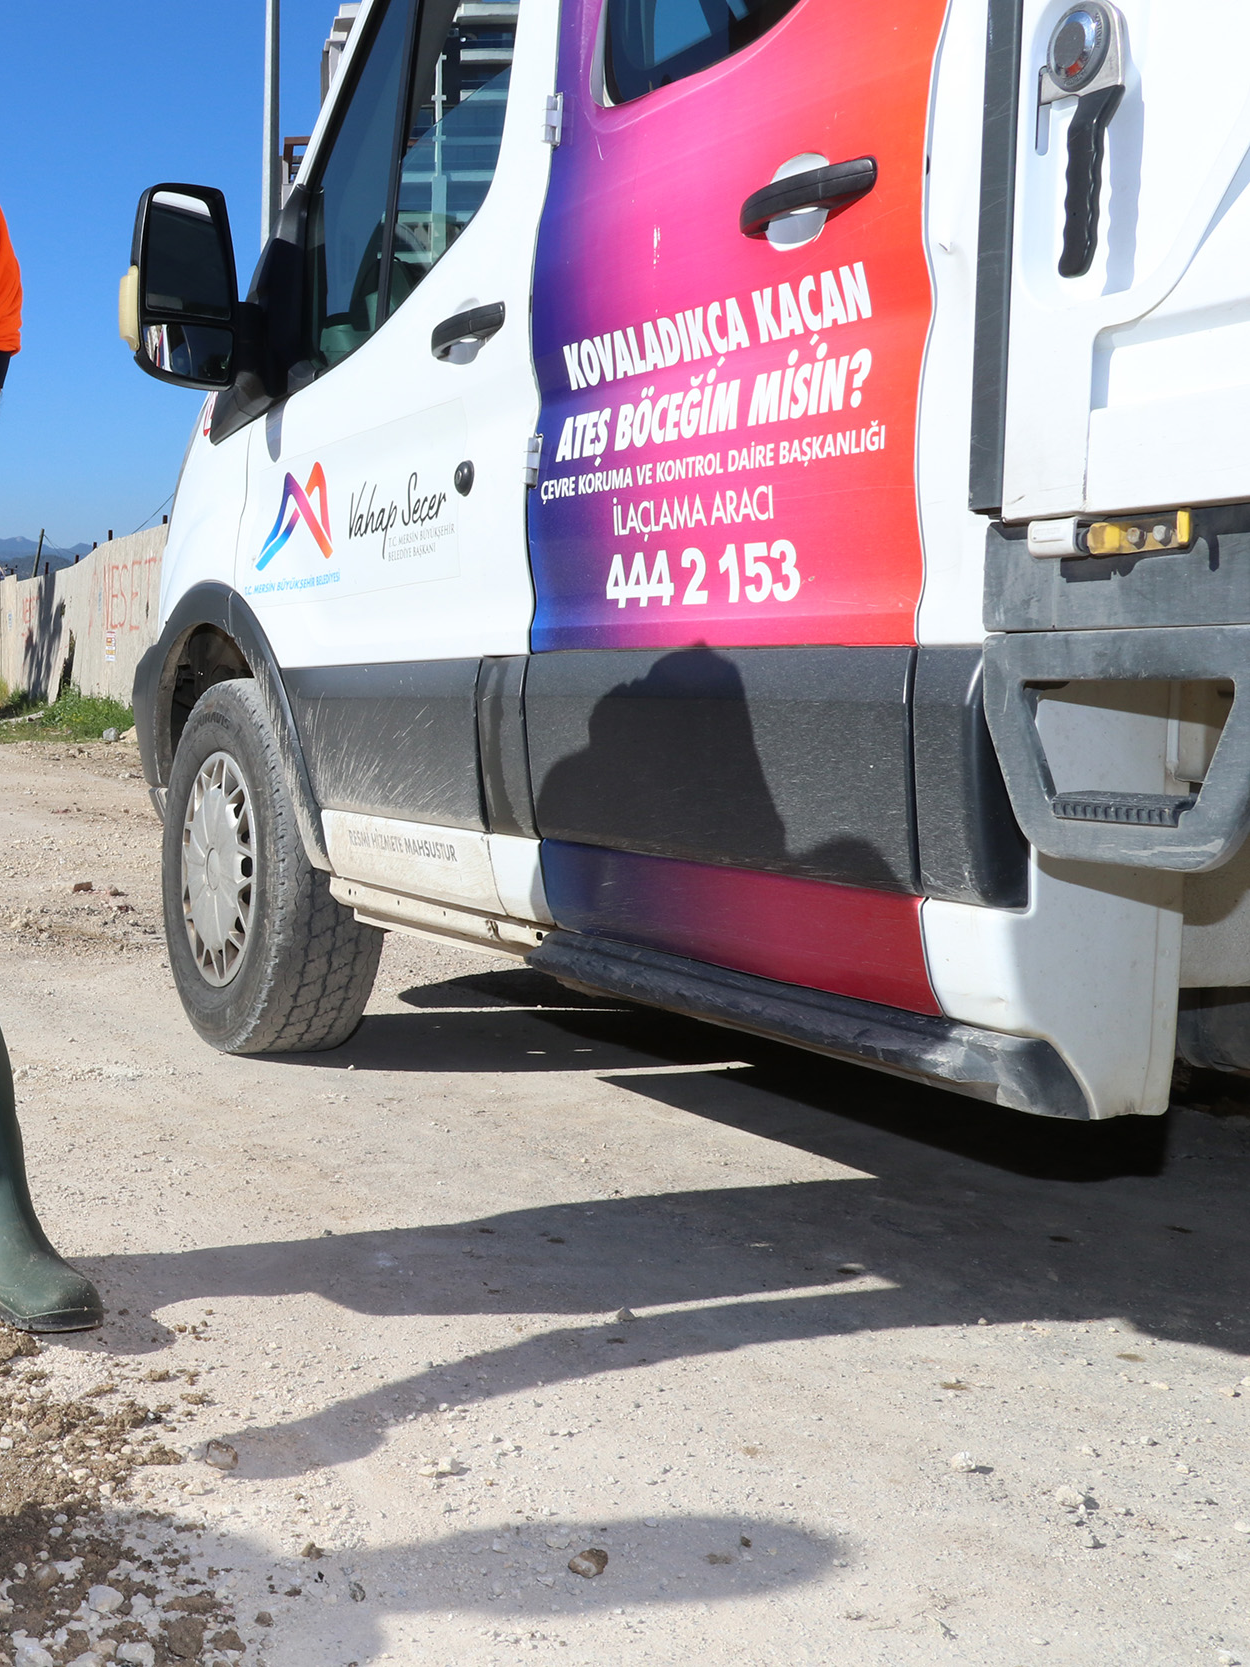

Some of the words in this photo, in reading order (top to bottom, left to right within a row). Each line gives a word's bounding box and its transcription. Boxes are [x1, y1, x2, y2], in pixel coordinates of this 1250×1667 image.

[562, 297, 750, 390] KOVALADIKÇA
[751, 261, 873, 345] KAÇAN
[555, 407, 613, 467] ATEŞ
[614, 368, 741, 451] BÖCEĞİM
[747, 342, 873, 427] MİSİN?
[540, 476, 576, 505] ÇEVRE
[577, 467, 633, 497] KORUMA
[635, 463, 653, 486] VE
[655, 452, 724, 483] KONTROL
[727, 441, 776, 472] DAİRE
[778, 420, 886, 467] BAŞKANLIĞI
[348, 481, 397, 560] Vahap
[401, 471, 447, 526] Seçer
[612, 493, 708, 542] İLAÇLAMA
[710, 485, 775, 526] ARACI
[605, 550, 675, 609] 444
[680, 547, 709, 605] 2
[718, 539, 801, 603] 153
[403, 837, 458, 862] MAHSUSTUR
